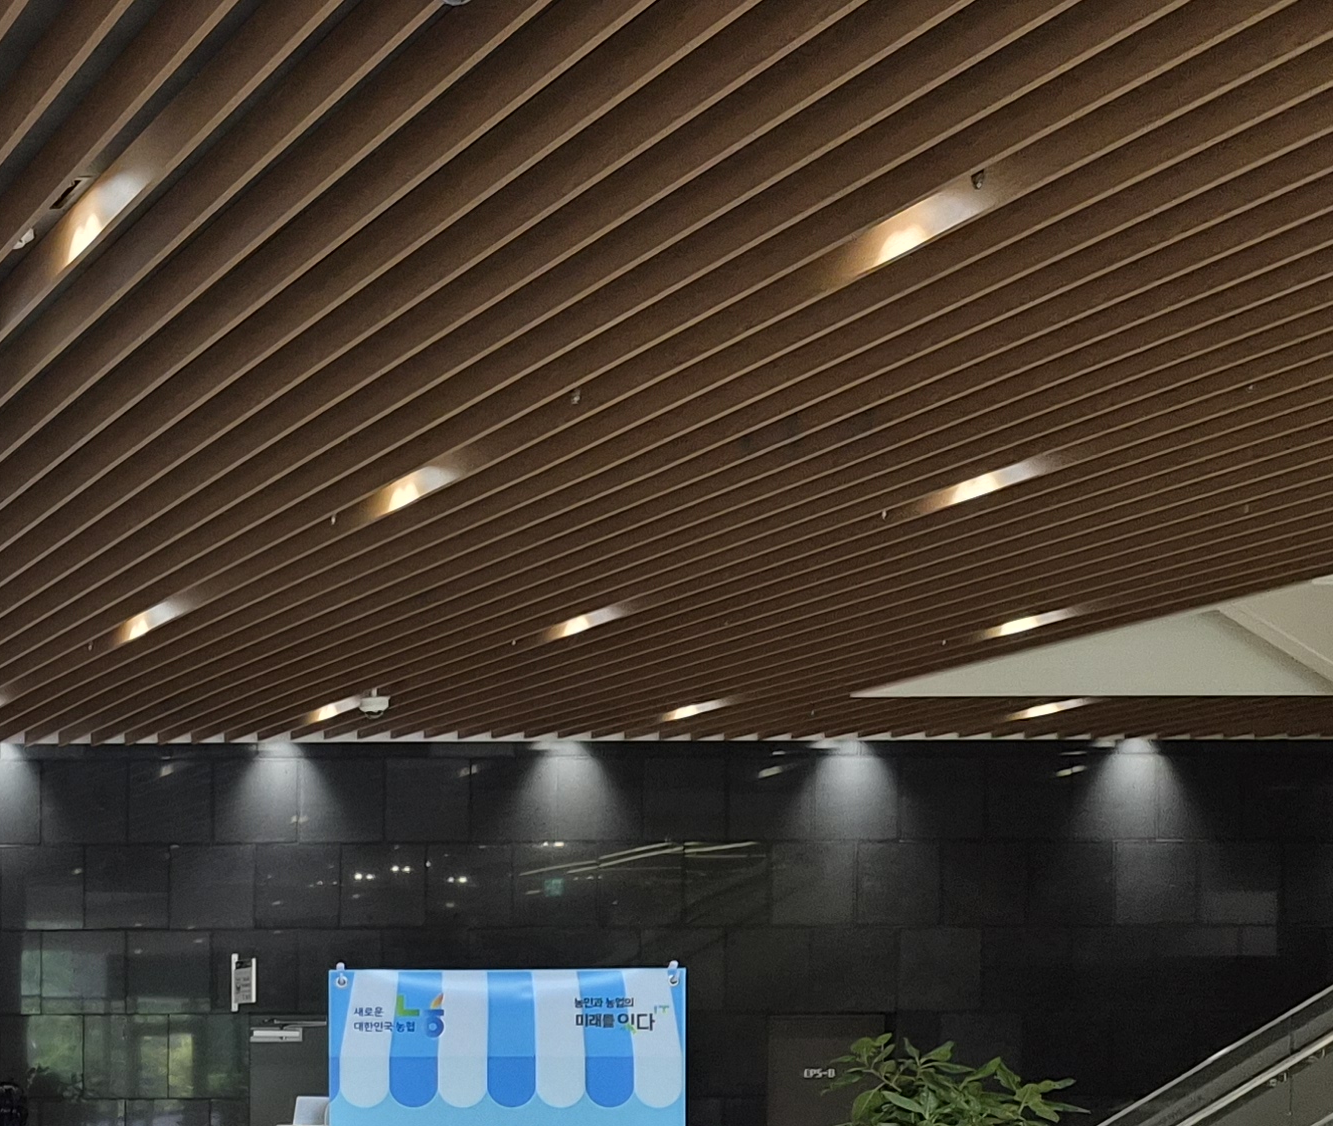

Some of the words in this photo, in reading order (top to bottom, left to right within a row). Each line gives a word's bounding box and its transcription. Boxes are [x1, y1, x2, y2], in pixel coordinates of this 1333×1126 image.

[574, 997, 603, 1008] 농민과
[354, 1007, 384, 1017] 새로운
[576, 1013, 614, 1028] 미래를
[354, 1021, 394, 1032] 대한민국
[395, 1021, 416, 1032] 농협
